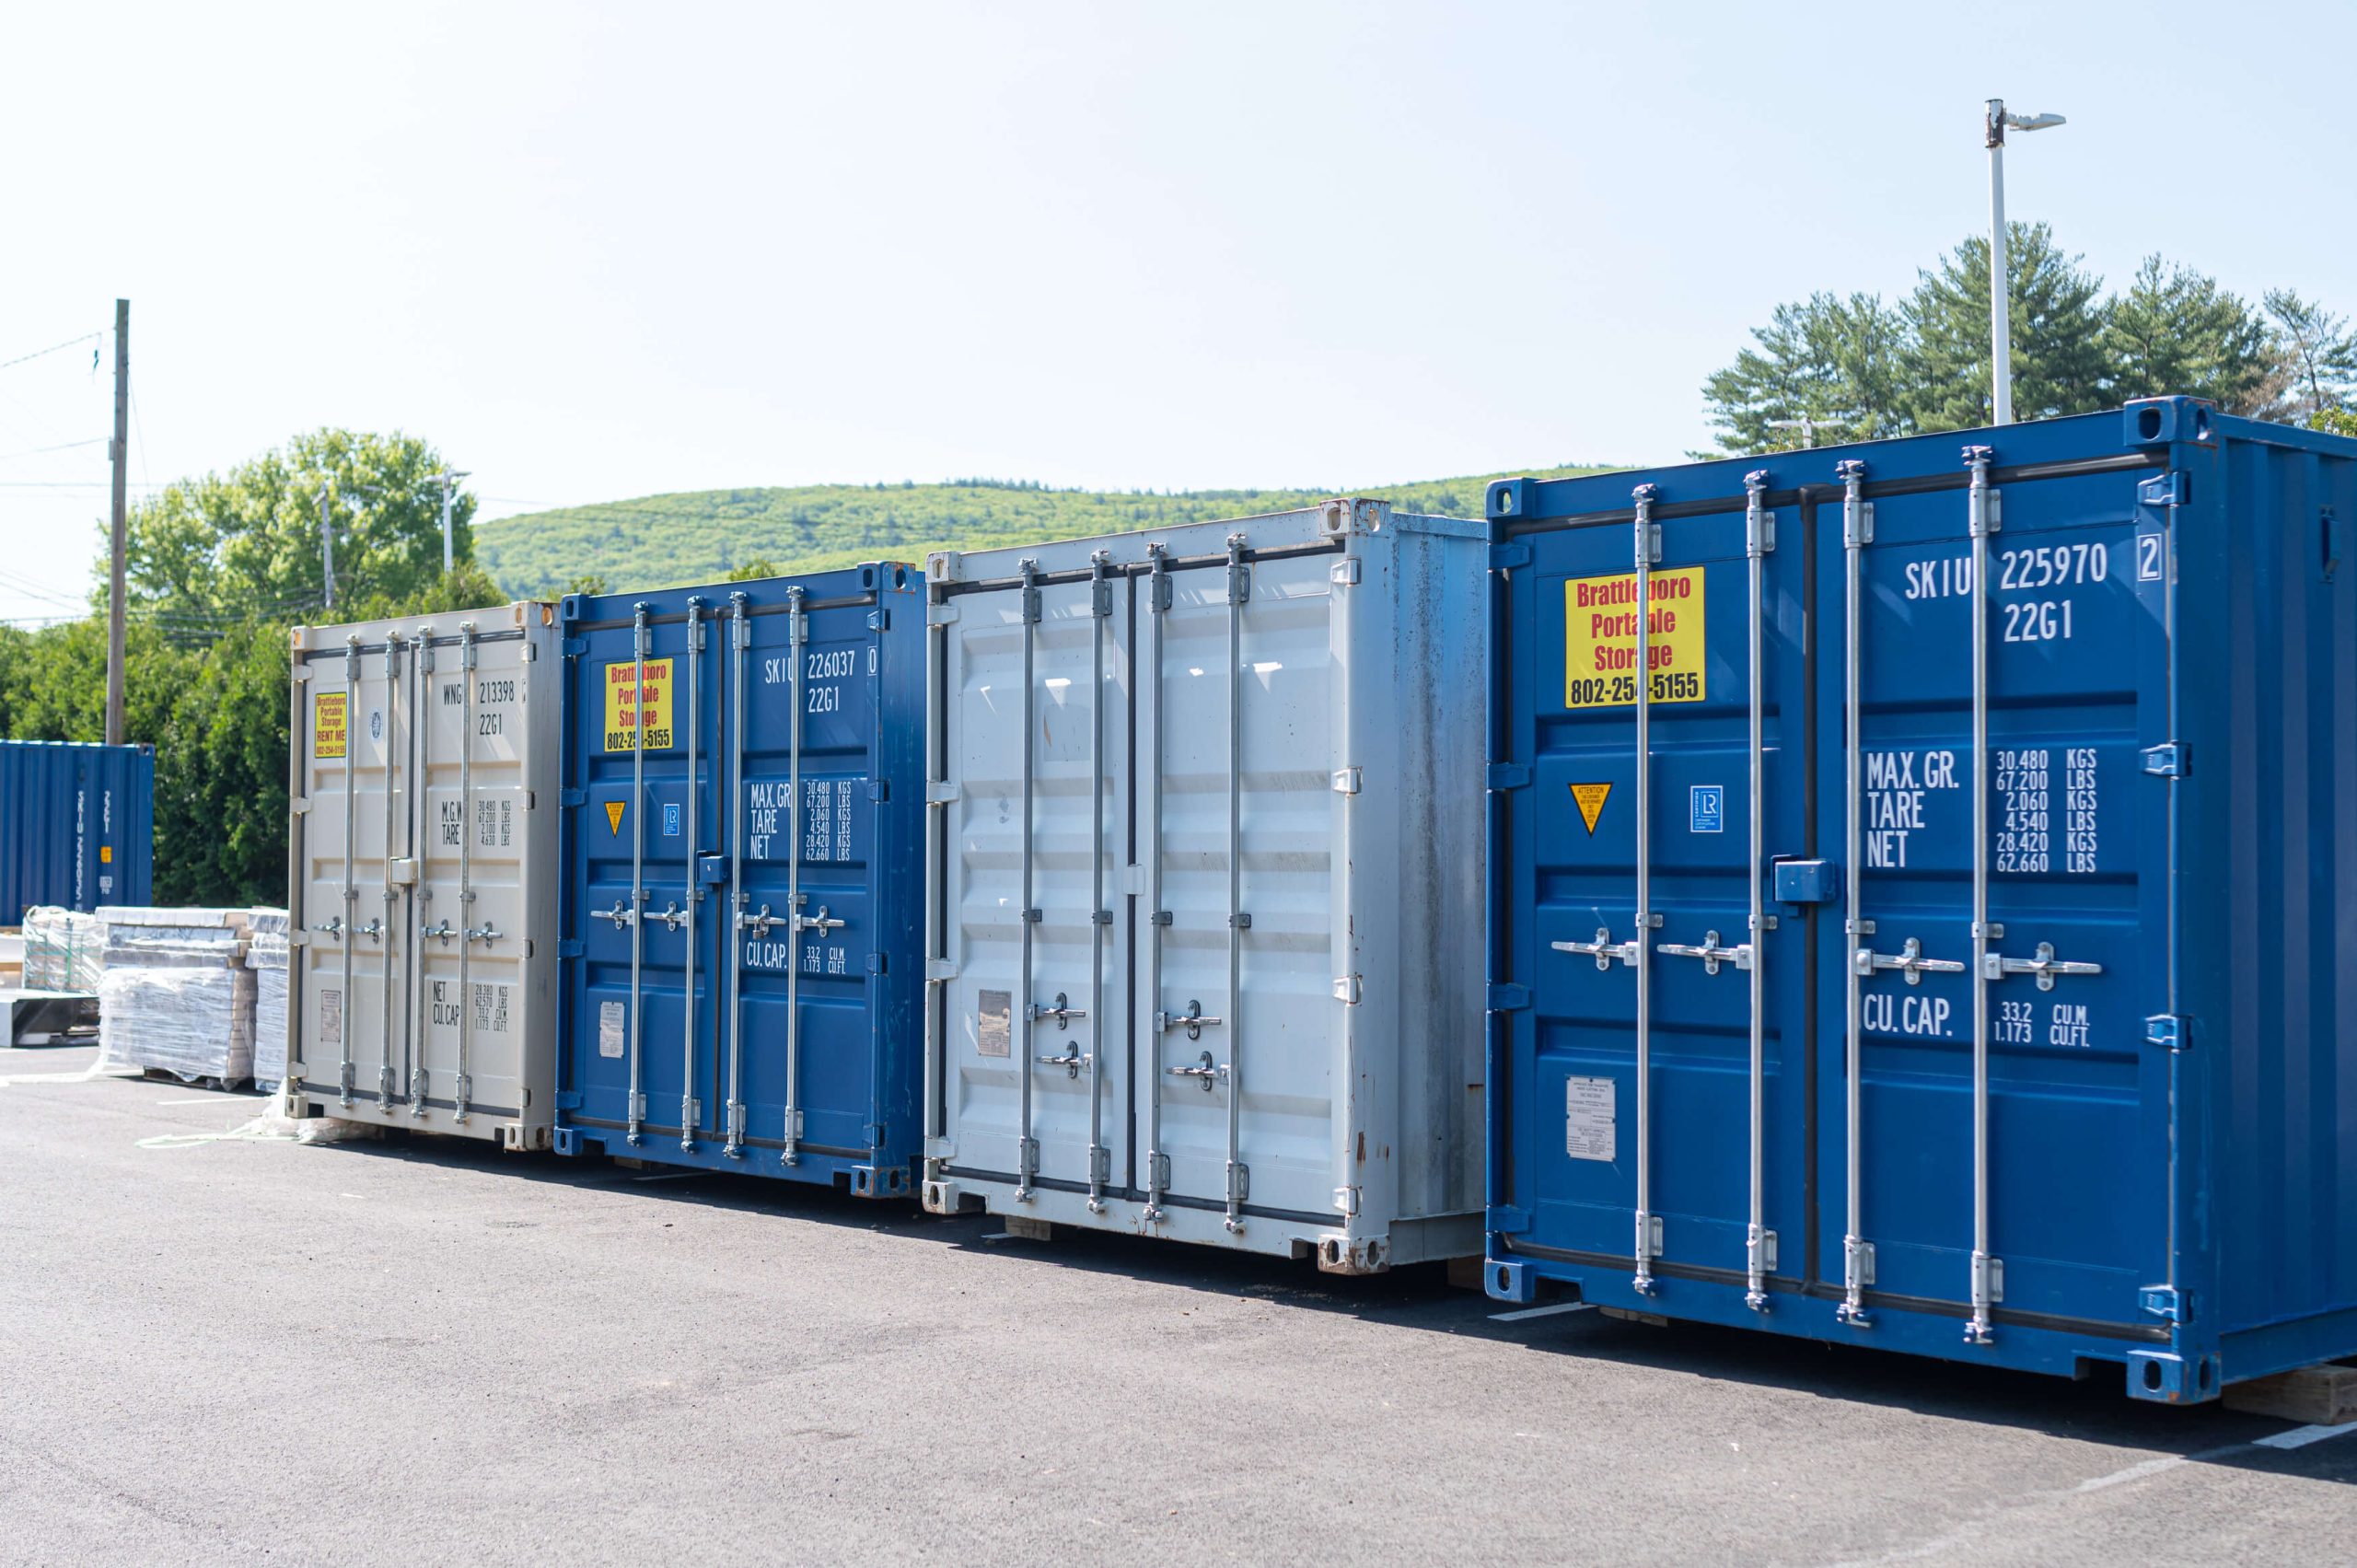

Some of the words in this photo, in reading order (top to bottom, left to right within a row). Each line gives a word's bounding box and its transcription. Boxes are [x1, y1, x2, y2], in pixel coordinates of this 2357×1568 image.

[1905, 557, 1971, 599] SKIU
[2001, 543, 2107, 589] 225970
[2141, 538, 2158, 578] 2
[2004, 599, 2071, 643] 22G1
[808, 650, 854, 679] 226037
[869, 648, 877, 674] 0
[611, 665, 666, 683] Brattboro
[444, 683, 462, 705] WNG
[480, 680, 515, 703] 213398
[618, 685, 658, 705] Porble
[1572, 672, 1699, 704] 802-25-5155
[808, 686, 839, 713] 22G1
[320, 706, 343, 716] Portable
[620, 709, 656, 727] Stoge
[321, 717, 342, 728] Storage
[480, 713, 502, 736] 22G1
[317, 730, 333, 742] RENT
[335, 729, 345, 741] ME
[608, 729, 669, 749] 802-2-5155
[1996, 750, 2049, 770] 30.480
[2066, 749, 2096, 769] KGS
[807, 782, 830, 795] 30.480
[837, 781, 852, 795] KGS
[1996, 771, 2049, 790] 67.200
[2067, 770, 2096, 789] LBS
[807, 795, 830, 807] 67.200
[837, 795, 851, 807] LBS
[1867, 791, 1925, 829] TARE
[2005, 792, 2049, 811] 2.060
[2066, 791, 2097, 810] KGS
[750, 809, 777, 834] TARE
[810, 808, 830, 821] 2.060
[837, 808, 851, 821] KGS
[2005, 811, 2049, 831] 4.540
[2067, 811, 2096, 830] LBS
[442, 824, 459, 845] TARE
[810, 821, 830, 834] 4.540
[837, 821, 851, 834] LBS
[750, 835, 770, 860] NET
[806, 835, 830, 848] 28.420
[837, 834, 851, 848] KGS
[1867, 830, 1908, 867] NET
[1996, 832, 2049, 852] 28.420
[2066, 832, 2097, 852] KGS
[806, 848, 830, 861] 62.660
[837, 848, 851, 862] LBS
[1996, 854, 2049, 873] 62.660
[2067, 853, 2096, 873] LBS
[433, 981, 447, 1003] NET
[2001, 1002, 2032, 1022] 33.2
[2052, 1004, 2090, 1026] CU.M.
